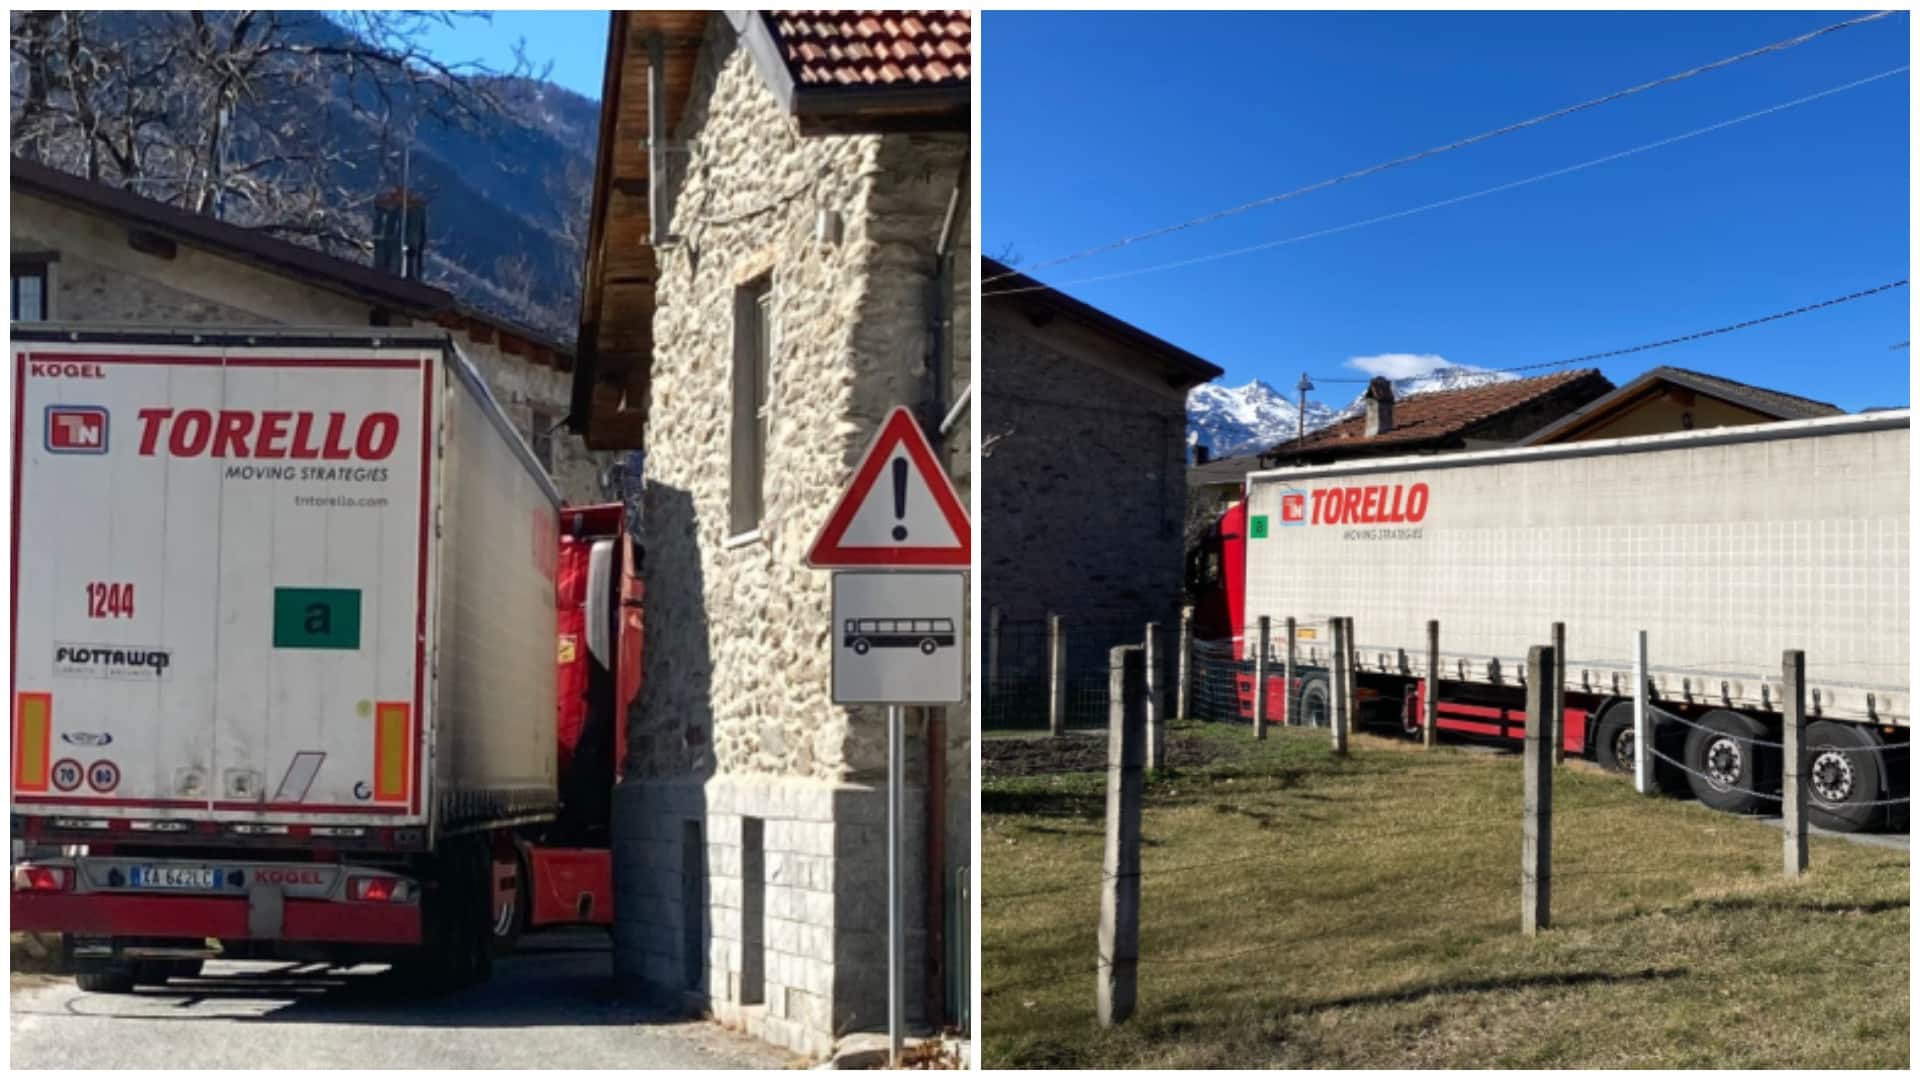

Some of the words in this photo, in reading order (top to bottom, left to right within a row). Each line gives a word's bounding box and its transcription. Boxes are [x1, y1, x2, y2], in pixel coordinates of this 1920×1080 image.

[138, 408, 400, 461] TORELLO
[225, 466, 296, 480] MOVING
[300, 466, 388, 482] STRATEGIES
[1311, 482, 1430, 525] TORELLO
[86, 581, 134, 618] 1244
[304, 602, 331, 635] a
[61, 768, 74, 783] 70
